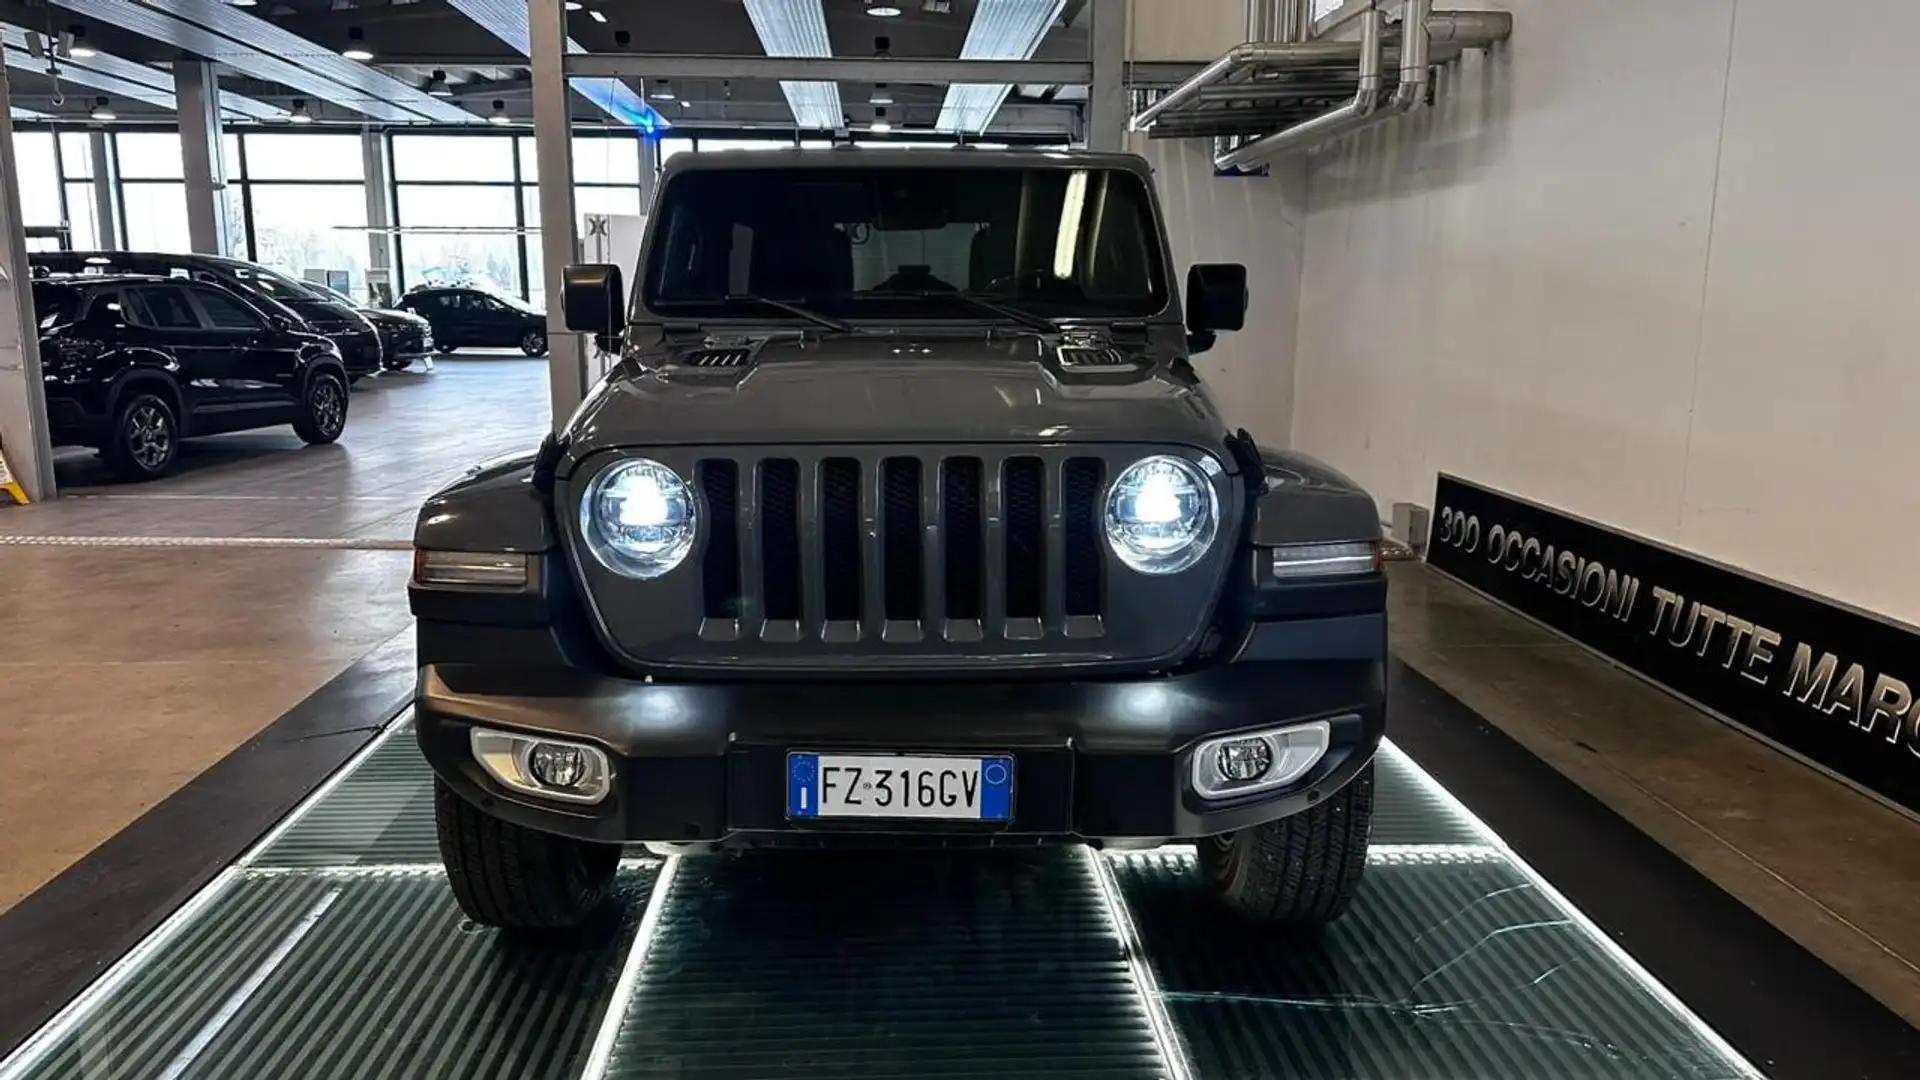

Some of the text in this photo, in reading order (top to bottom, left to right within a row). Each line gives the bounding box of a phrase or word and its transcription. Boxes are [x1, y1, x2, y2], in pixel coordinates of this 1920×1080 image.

[1440, 505, 1480, 553] 300
[1487, 524, 1639, 622] OCCASIONI
[1648, 586, 1782, 684] TUTTE
